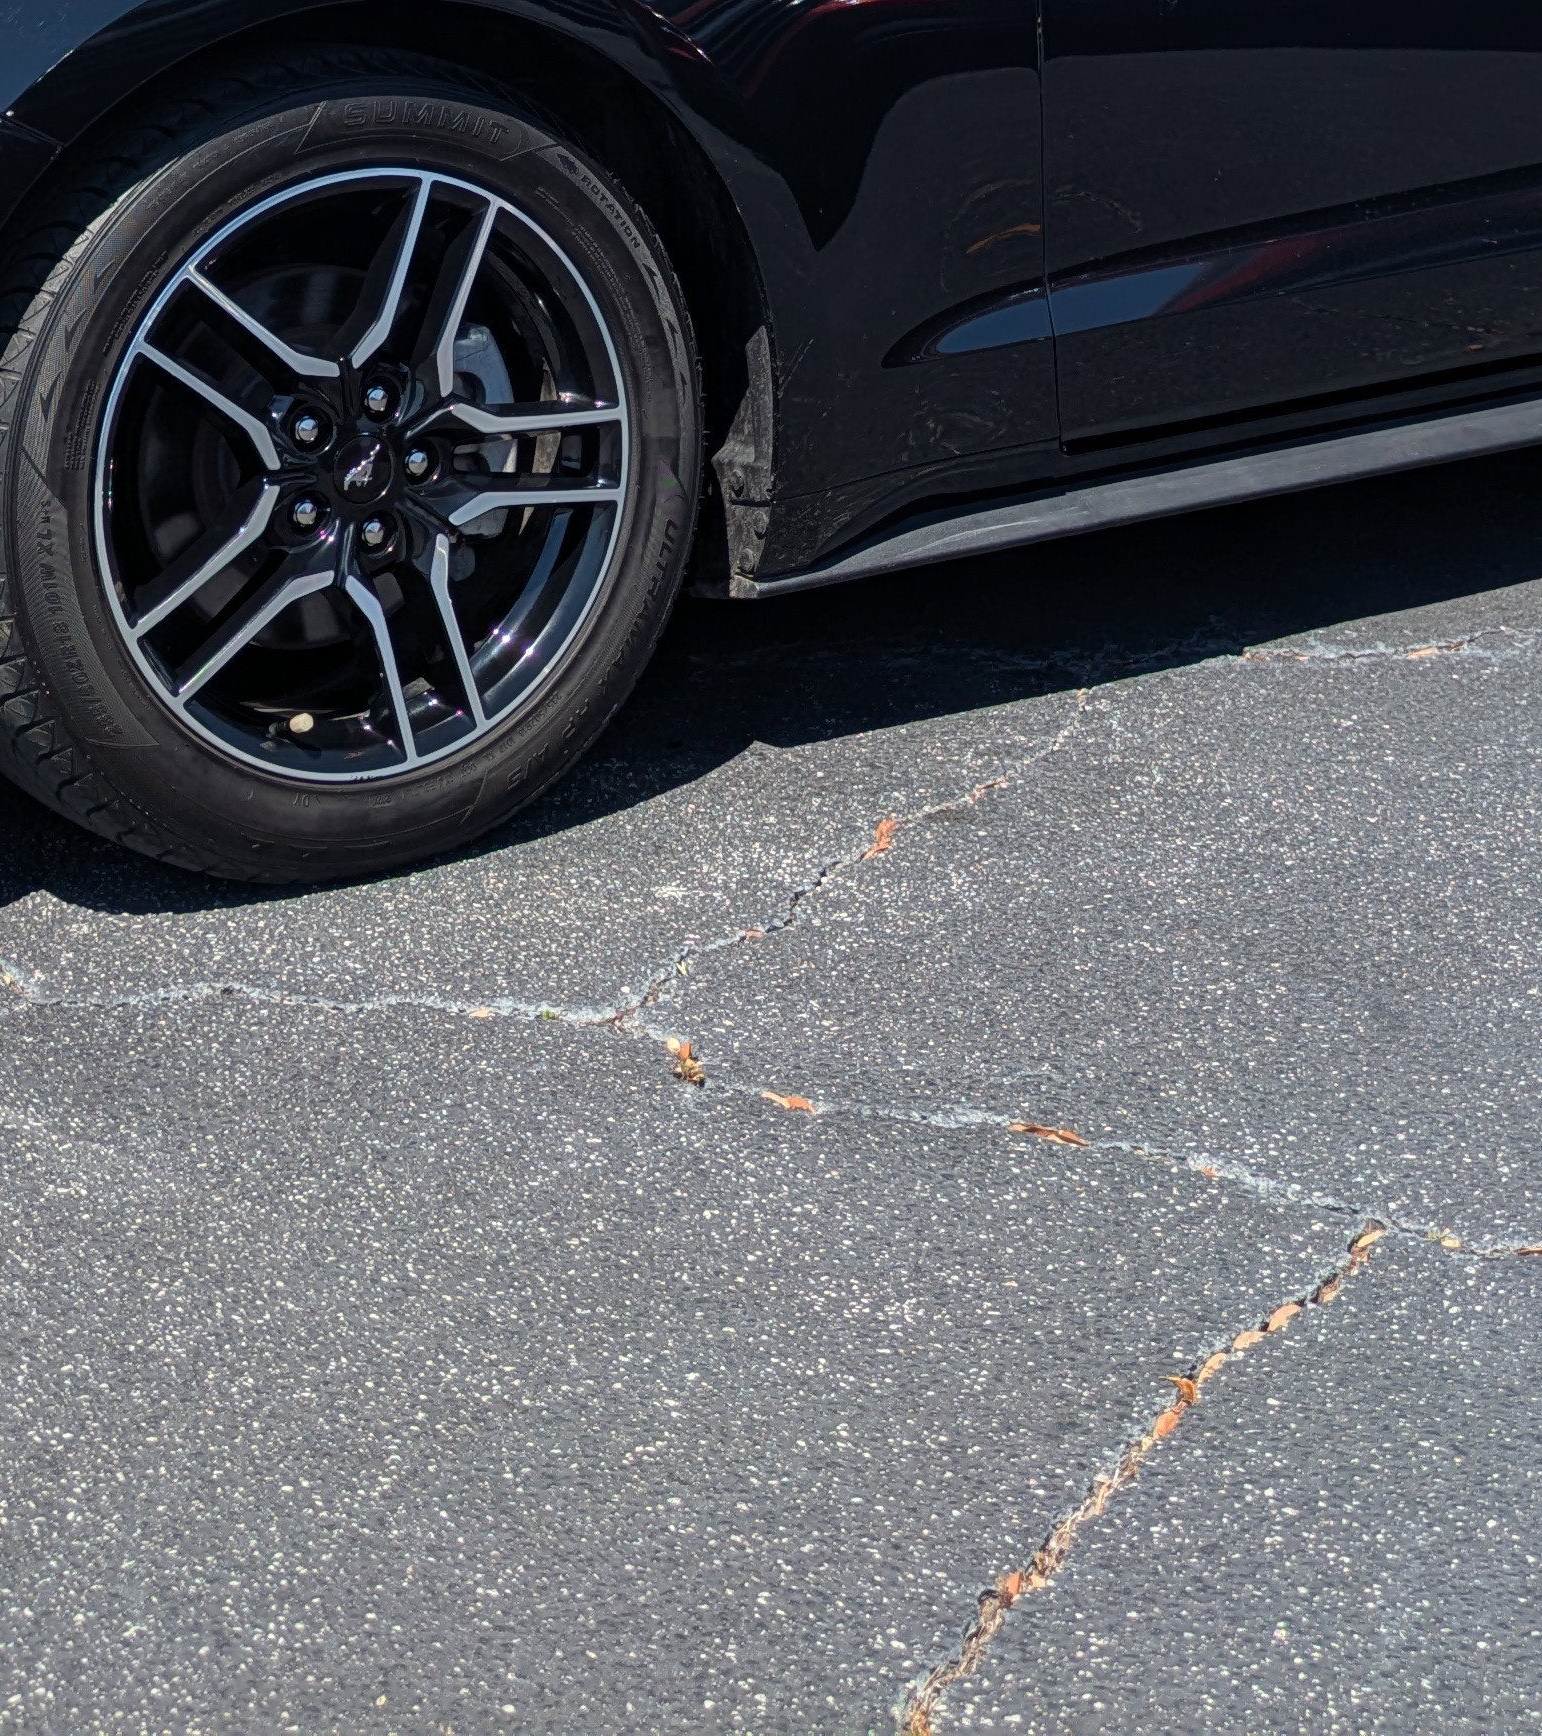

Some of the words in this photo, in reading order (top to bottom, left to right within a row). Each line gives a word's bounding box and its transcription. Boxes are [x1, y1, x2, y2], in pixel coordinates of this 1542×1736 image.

[343, 100, 510, 145] SUMMIT
[580, 173, 641, 249] ROTATION
[36, 528, 54, 557] XL
